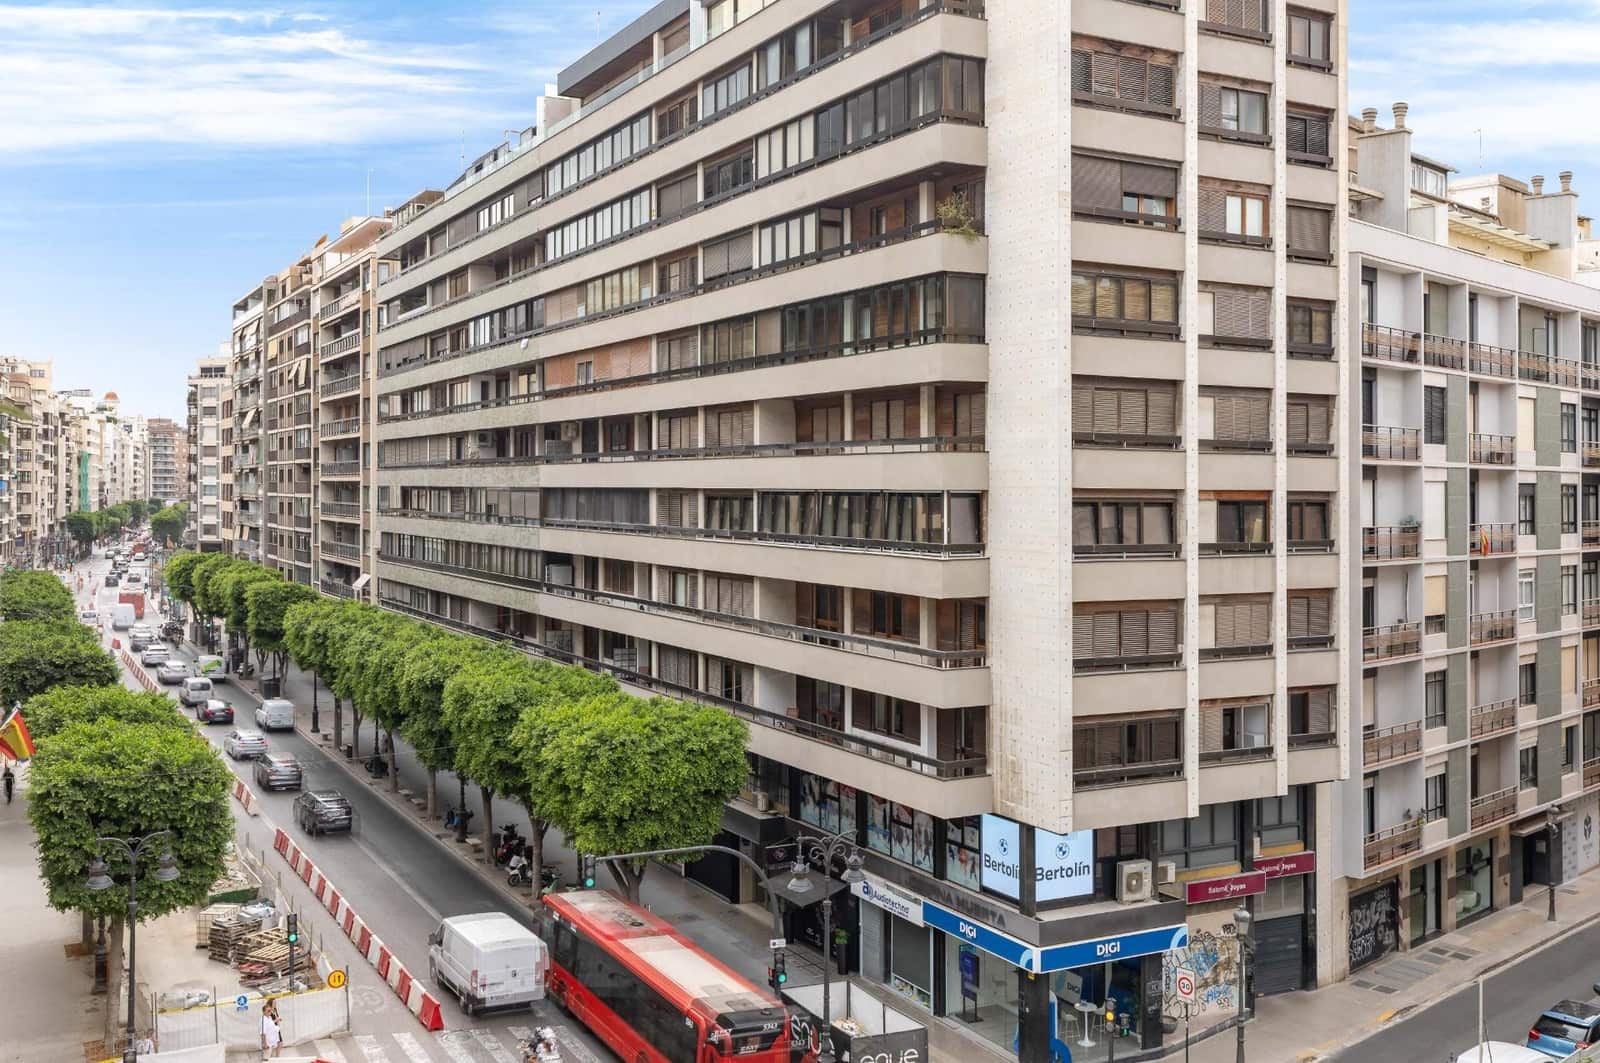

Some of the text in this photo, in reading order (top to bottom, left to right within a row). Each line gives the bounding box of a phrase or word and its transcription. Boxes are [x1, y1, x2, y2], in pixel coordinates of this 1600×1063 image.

[984, 853, 1019, 879] Bertolí
[1035, 861, 1090, 881] Bertolín
[960, 921, 977, 939] DIGI
[1097, 941, 1120, 956] DIGI
[1181, 981, 1190, 991] 30
